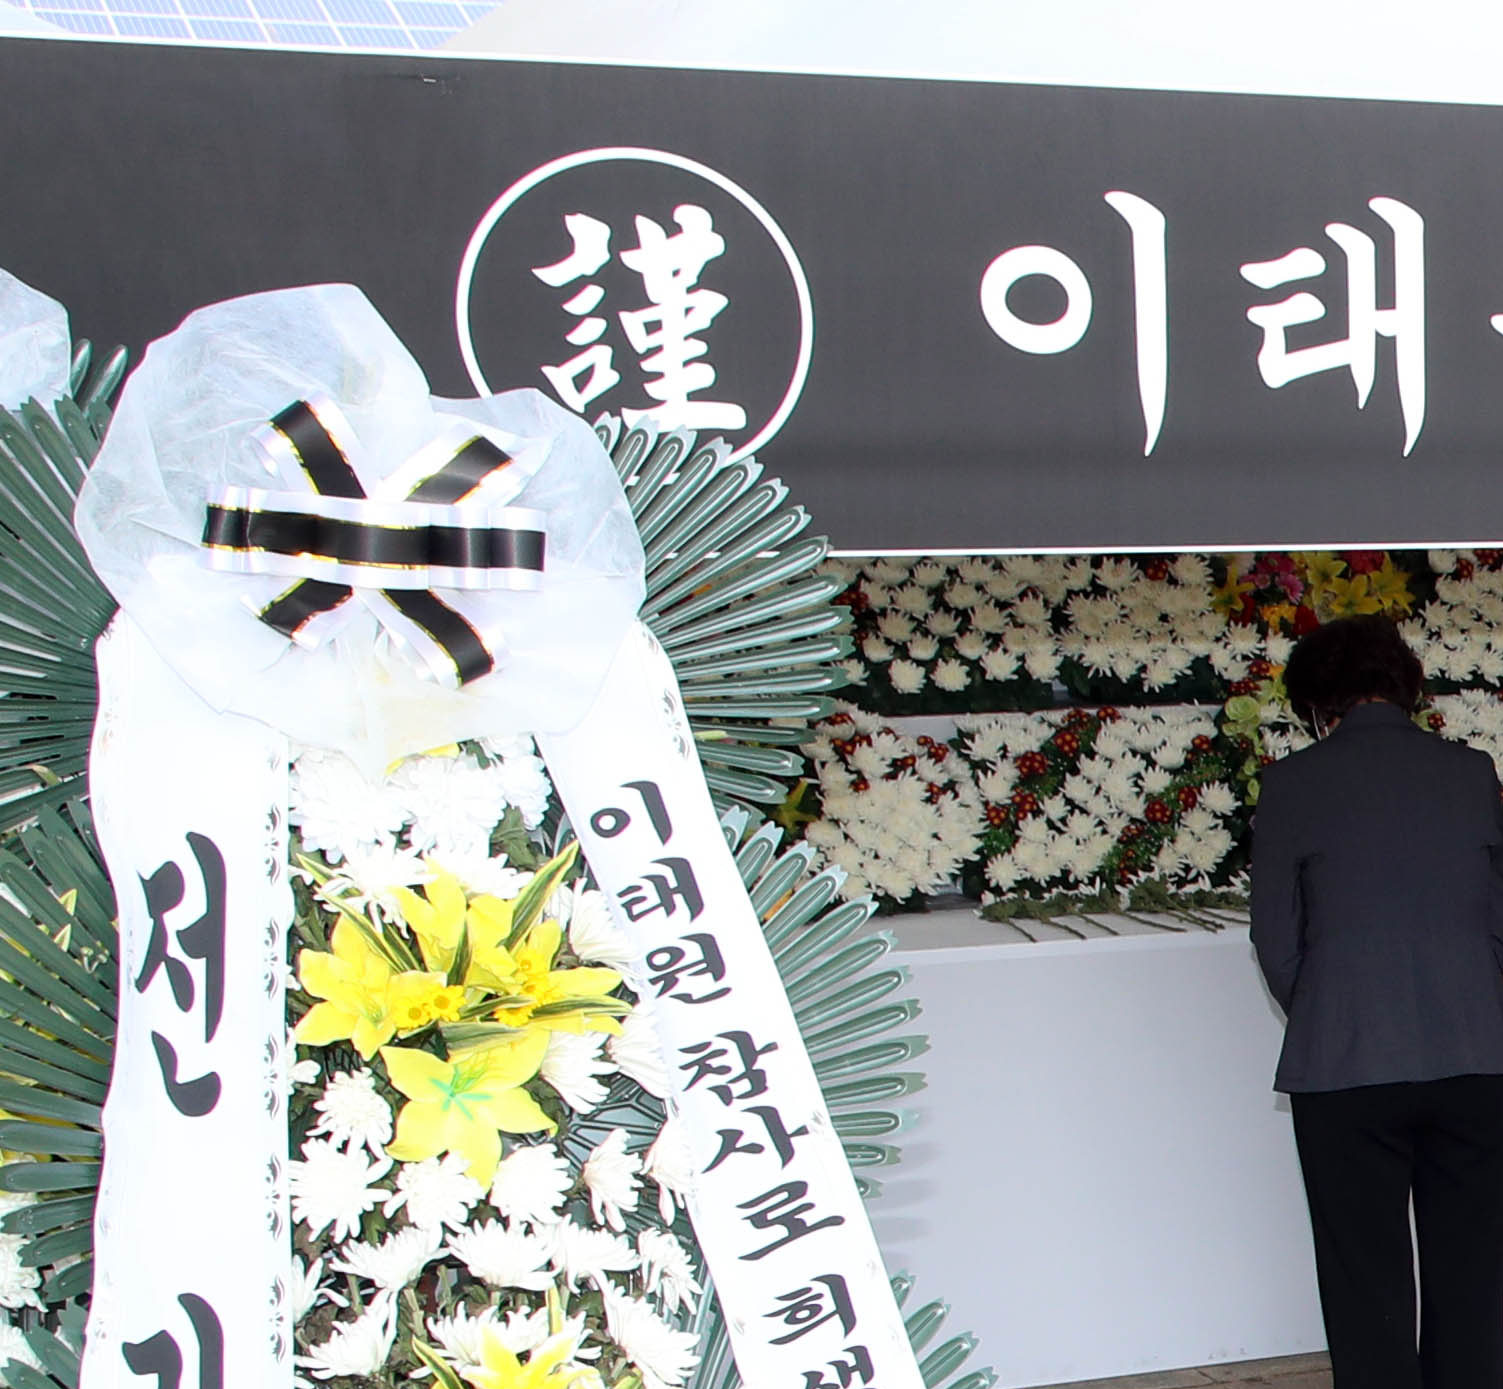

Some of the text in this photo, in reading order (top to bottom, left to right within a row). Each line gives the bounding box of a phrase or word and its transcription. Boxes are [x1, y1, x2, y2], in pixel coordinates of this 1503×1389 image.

[533, 204, 746, 431] 謹
[590, 780, 732, 1003] 이태원
[679, 1029, 846, 1264] 참사로
